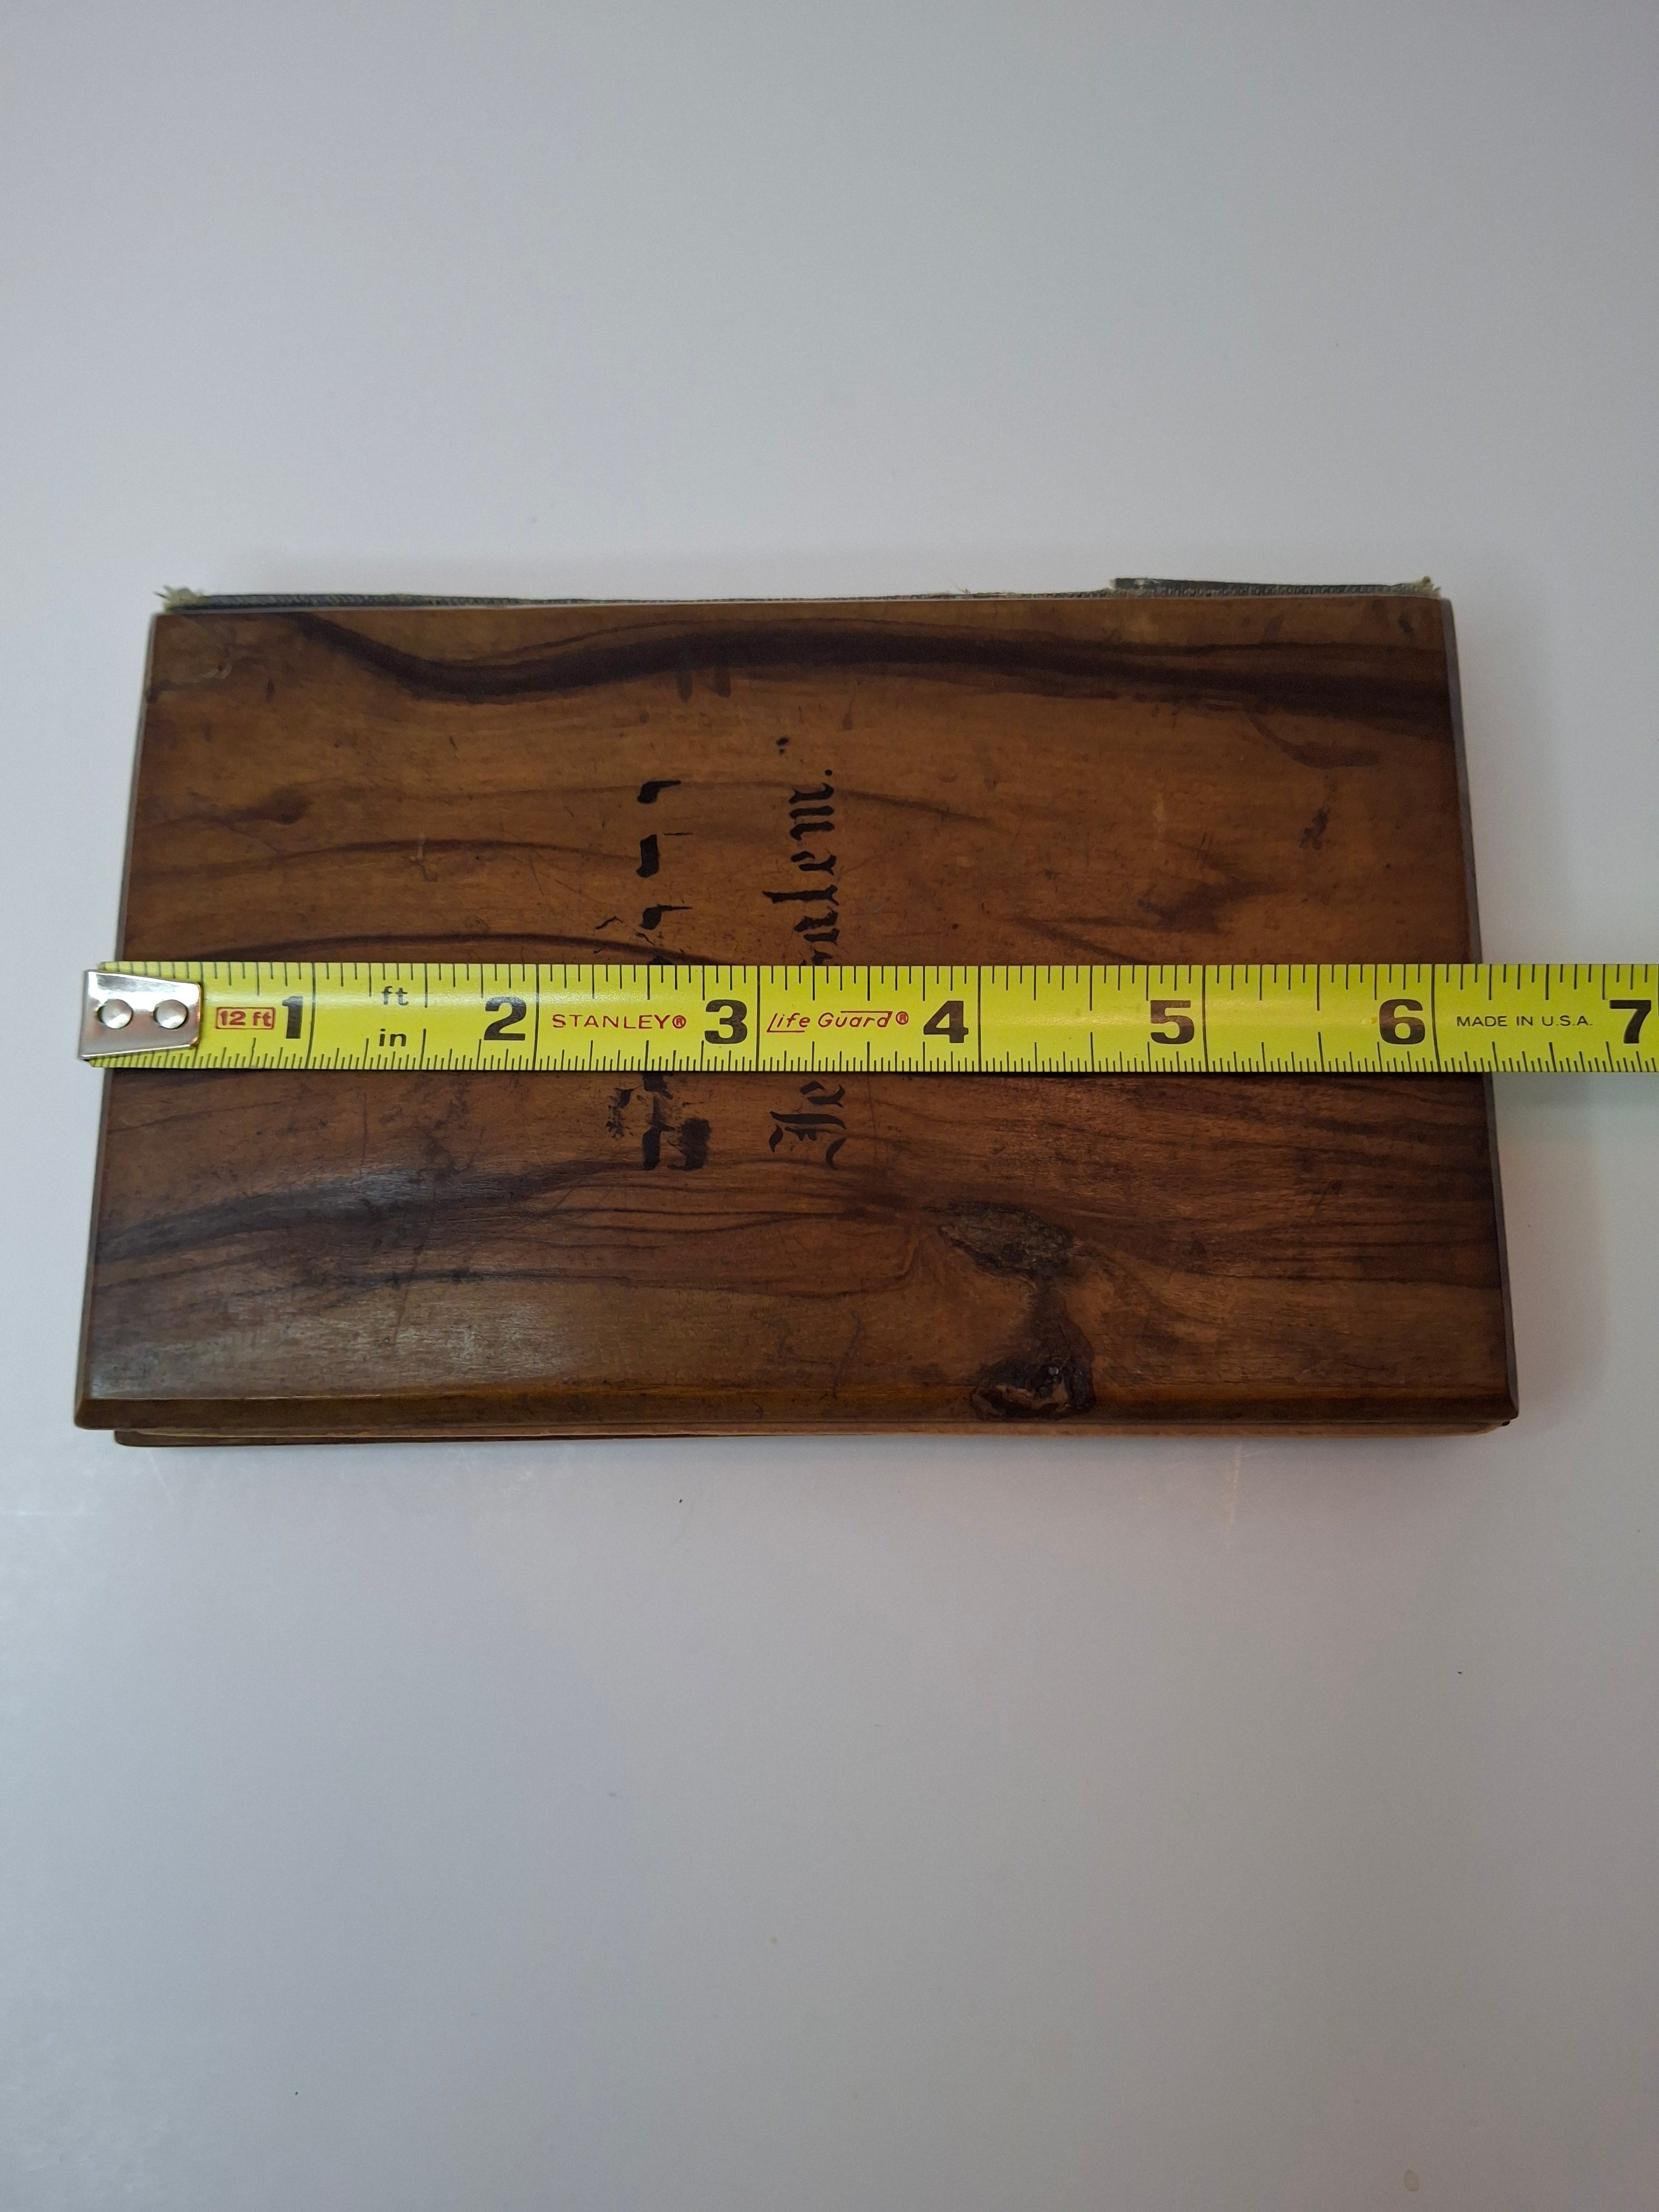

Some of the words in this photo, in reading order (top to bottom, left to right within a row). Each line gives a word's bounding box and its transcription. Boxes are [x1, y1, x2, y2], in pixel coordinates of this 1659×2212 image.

[281, 995, 304, 1039] 1
[381, 986, 409, 1006] ft
[219, 1010, 246, 1027] 12
[252, 1011, 272, 1027] ft
[378, 1028, 407, 1047] in
[483, 996, 527, 1041] 2
[704, 999, 748, 1045] 3
[766, 1012, 811, 1033] Life
[923, 1000, 969, 1044] 4
[1150, 999, 1195, 1045] 5
[1379, 998, 1426, 1045] 6
[1456, 1015, 1508, 1027] MADE
[1516, 1015, 1534, 1027] IN
[1609, 999, 1652, 1044] 7
